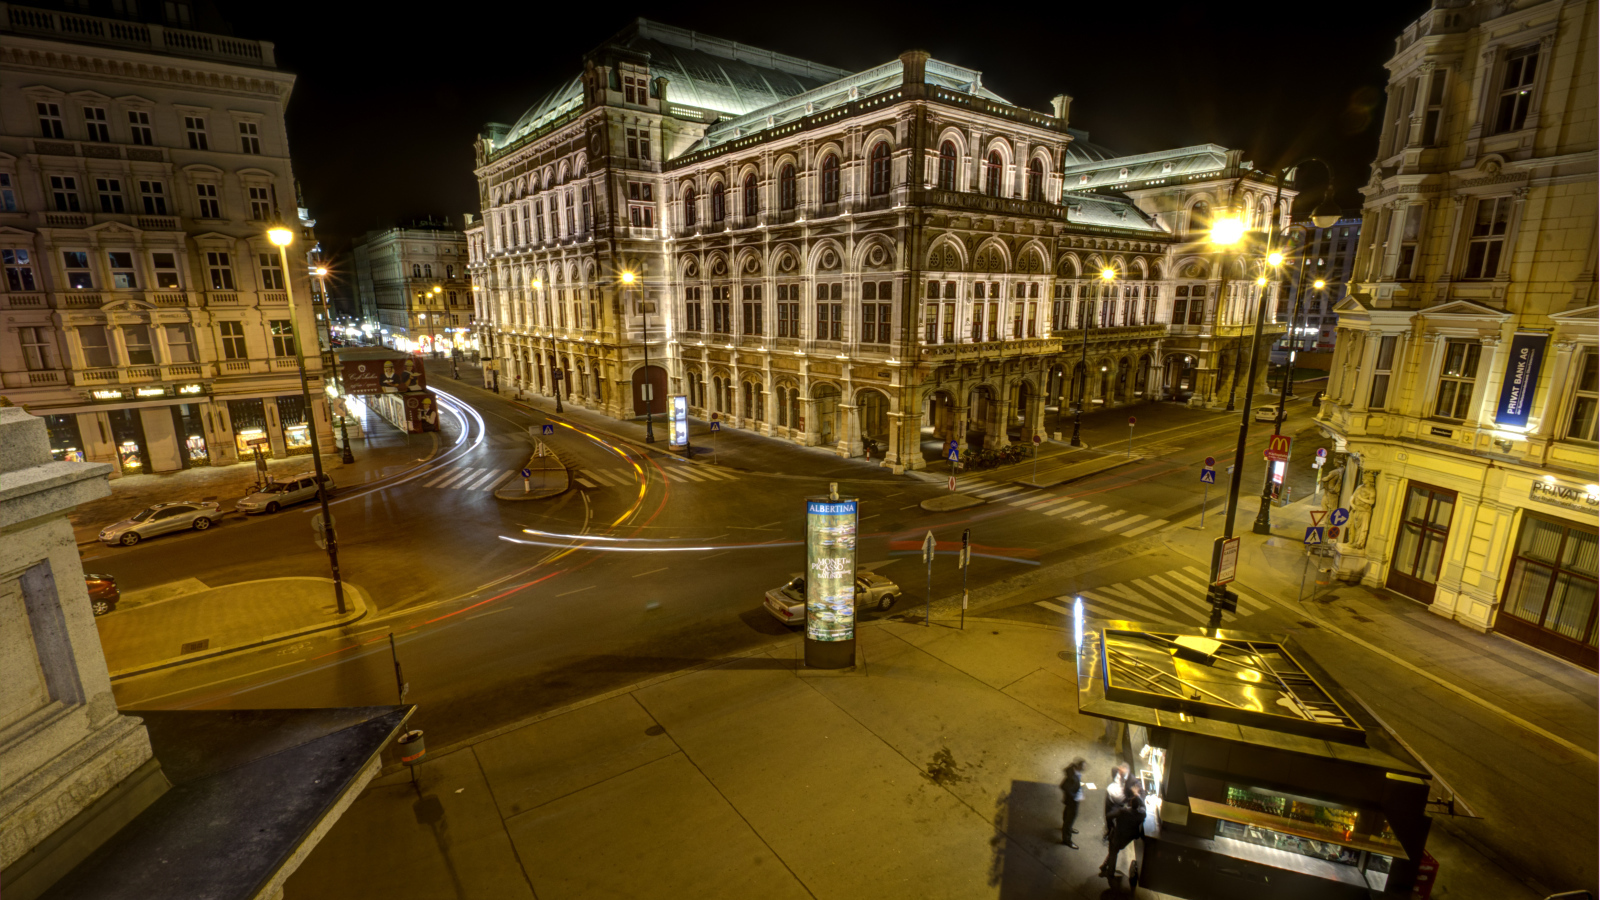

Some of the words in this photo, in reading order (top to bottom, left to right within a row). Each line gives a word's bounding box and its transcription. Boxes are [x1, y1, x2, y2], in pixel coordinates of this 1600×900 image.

[1506, 386, 1520, 415] PRIVAT
[1513, 361, 1525, 385] BANK
[1519, 347, 1529, 360] AG
[1533, 481, 1582, 502] PRIVAT
[809, 504, 854, 513] ALBERTINA
[817, 557, 846, 565] MONET
[811, 562, 844, 571] PICASSO
